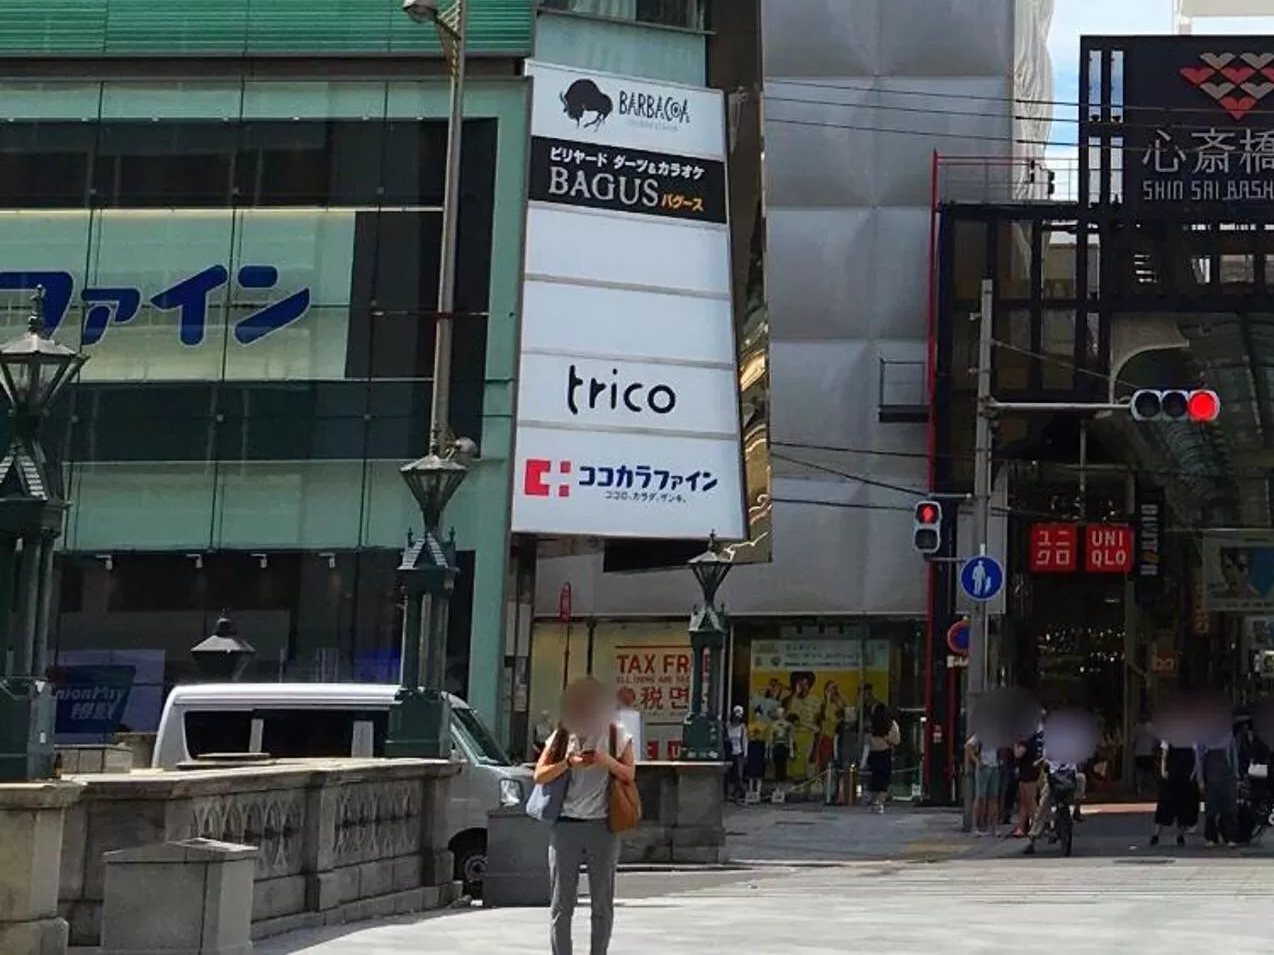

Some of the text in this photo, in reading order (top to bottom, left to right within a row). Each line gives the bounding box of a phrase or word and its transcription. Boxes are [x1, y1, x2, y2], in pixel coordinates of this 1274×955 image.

[619, 90, 690, 123] BARBACOA
[551, 147, 608, 167] ビリヤード
[549, 166, 659, 206] BAGUS
[1143, 180, 1183, 200] SHIN
[1191, 180, 1219, 200] SAI
[567, 364, 676, 415] trico
[579, 464, 718, 492] ココカラファイン
[1092, 530, 1124, 547] UNI
[1092, 549, 1127, 567] QLO
[616, 654, 656, 673] TAX
